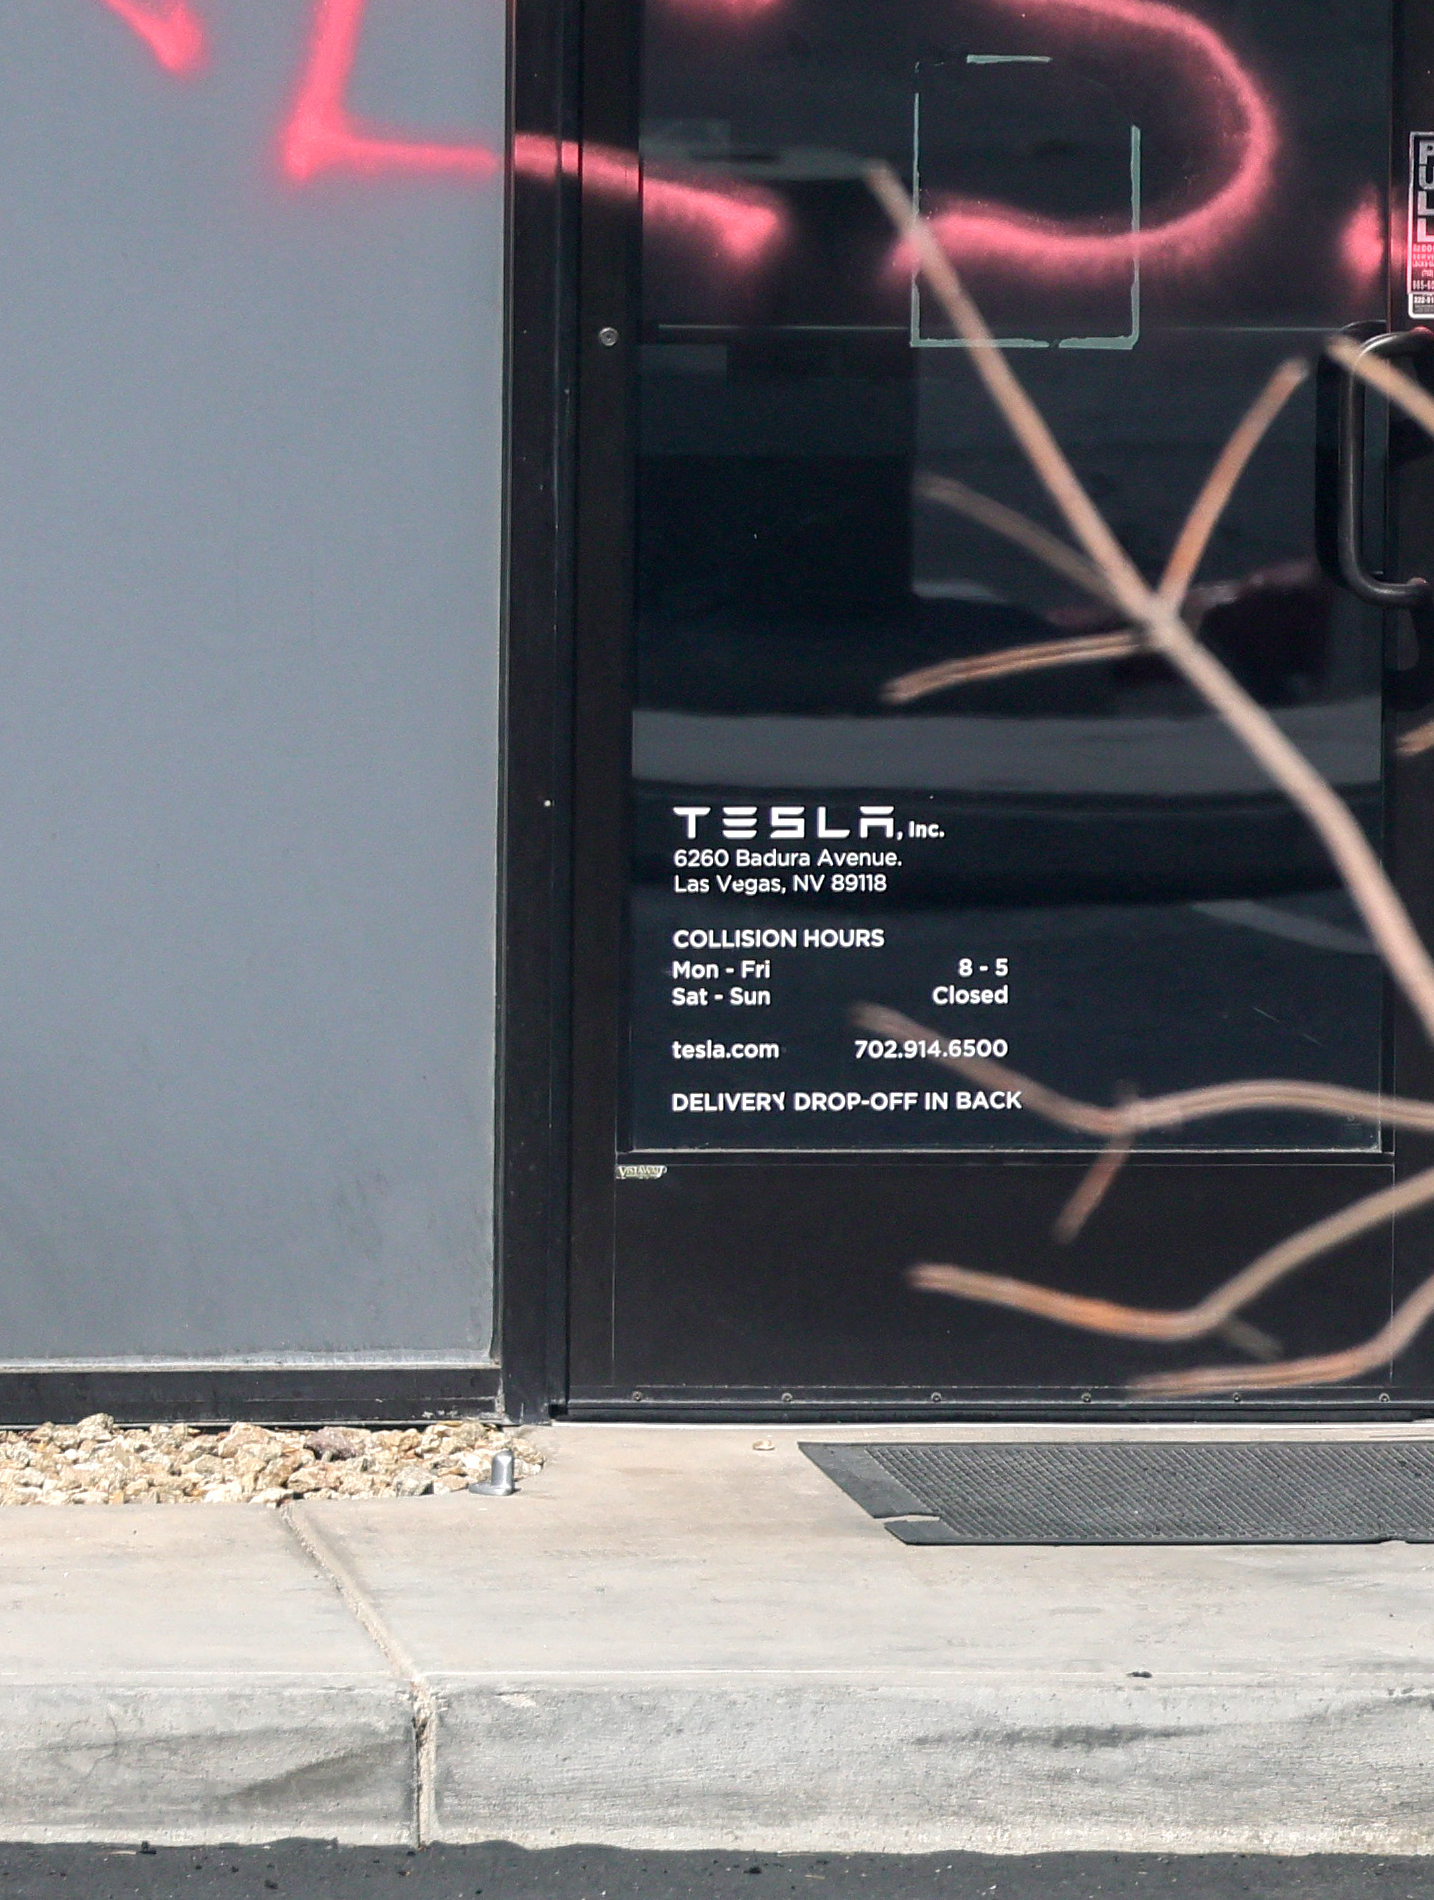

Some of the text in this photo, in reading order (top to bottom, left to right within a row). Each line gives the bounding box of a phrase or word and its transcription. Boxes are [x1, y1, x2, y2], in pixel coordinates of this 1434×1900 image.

[909, 821, 945, 839] Inc.
[674, 848, 902, 868] 6260 Badura Avenue.
[674, 874, 887, 897] Las Vegas, NV 89118
[673, 928, 885, 949] COLLISION HOURS
[673, 961, 719, 980] Mon
[741, 959, 771, 980] Fri
[958, 959, 973, 977] 8
[995, 958, 1009, 977] 5
[672, 987, 708, 1006] Sat
[729, 986, 771, 1006] Sun
[932, 984, 1009, 1005] Closed
[672, 1039, 780, 1060] tesla.com
[854, 1038, 1009, 1059] 702.914.6500
[672, 1090, 1022, 1112] DELIVERY DROP-OFF IN BACK
